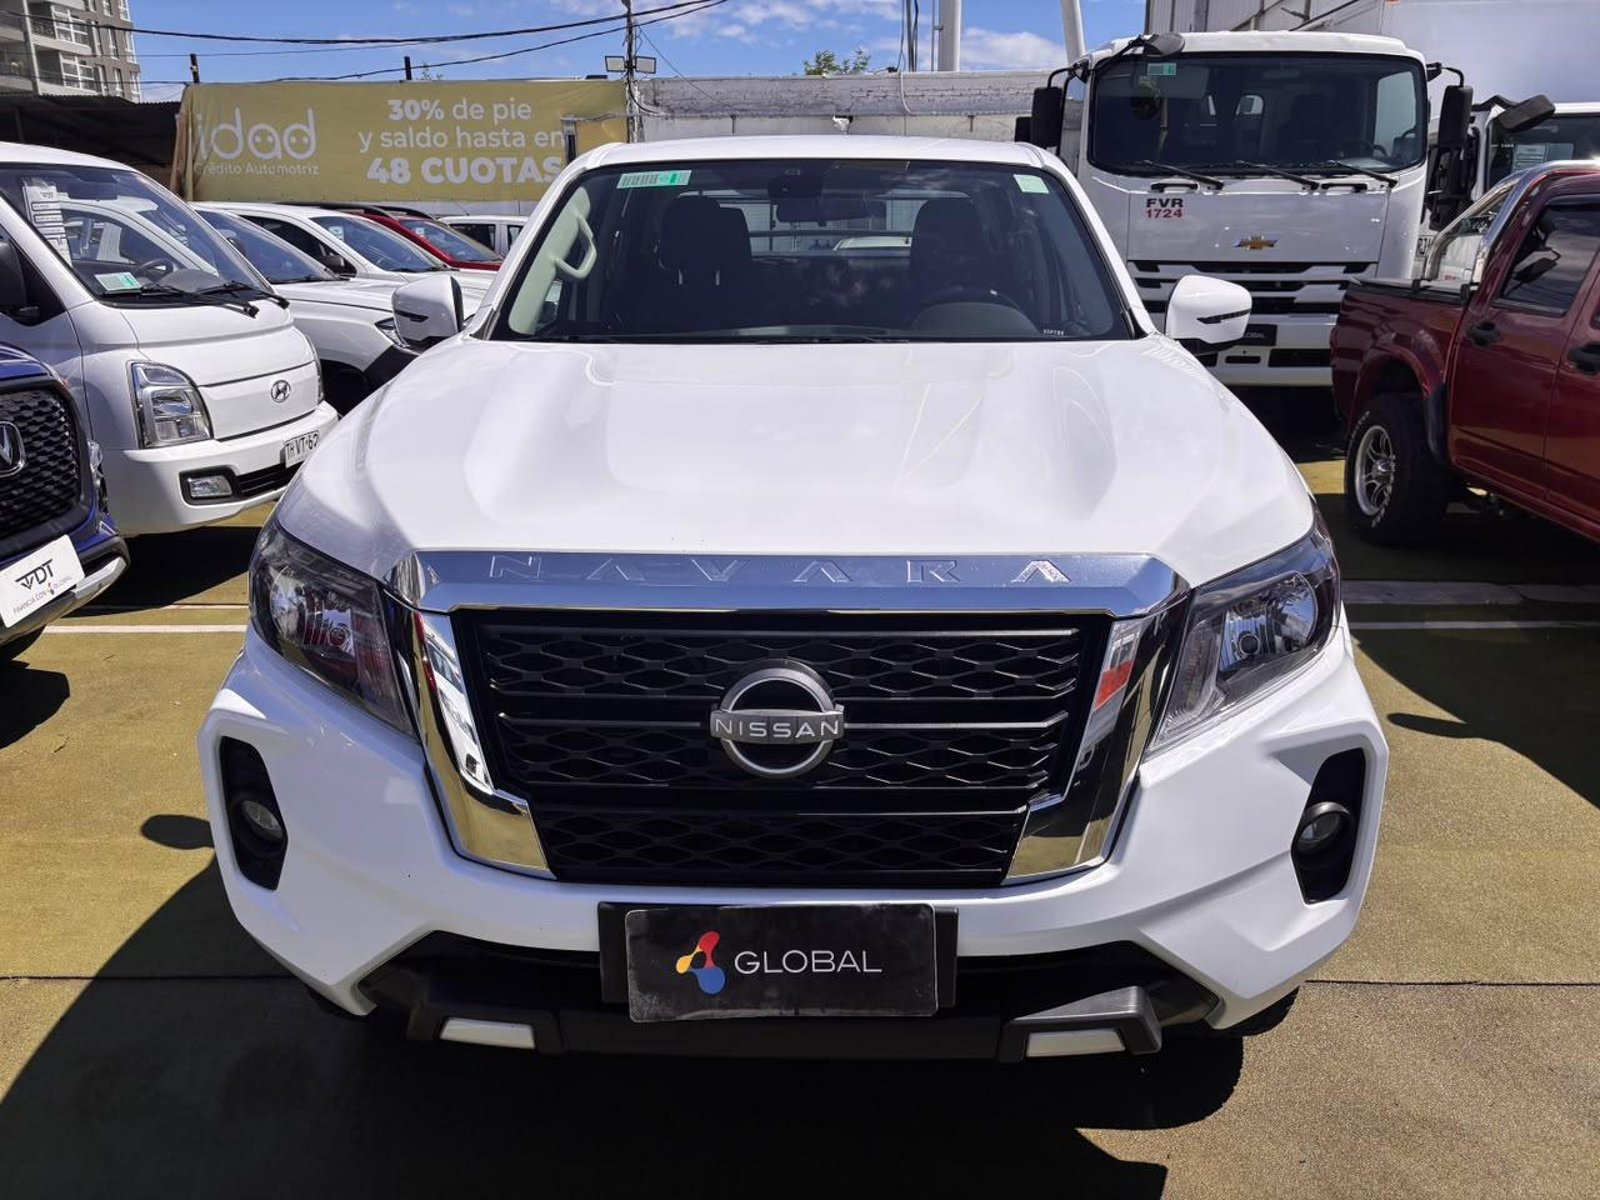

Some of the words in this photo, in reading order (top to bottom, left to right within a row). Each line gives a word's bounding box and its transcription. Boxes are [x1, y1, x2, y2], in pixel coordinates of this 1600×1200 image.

[388, 99, 445, 121] 30%
[452, 98, 485, 121] de
[493, 97, 533, 126] pie
[359, 130, 373, 153] y
[380, 127, 449, 149] saldo
[456, 127, 525, 149] hasta
[534, 131, 566, 149] en
[245, 163, 320, 176] Automotriz
[366, 157, 412, 185] 48
[421, 157, 561, 185] CUOTAS
[1145, 208, 1183, 219] 1724
[1146, 198, 1184, 208] FVR
[489, 555, 1072, 583] NAVARA
[715, 718, 839, 739] NISSAN
[734, 949, 882, 975] GLOBAL
